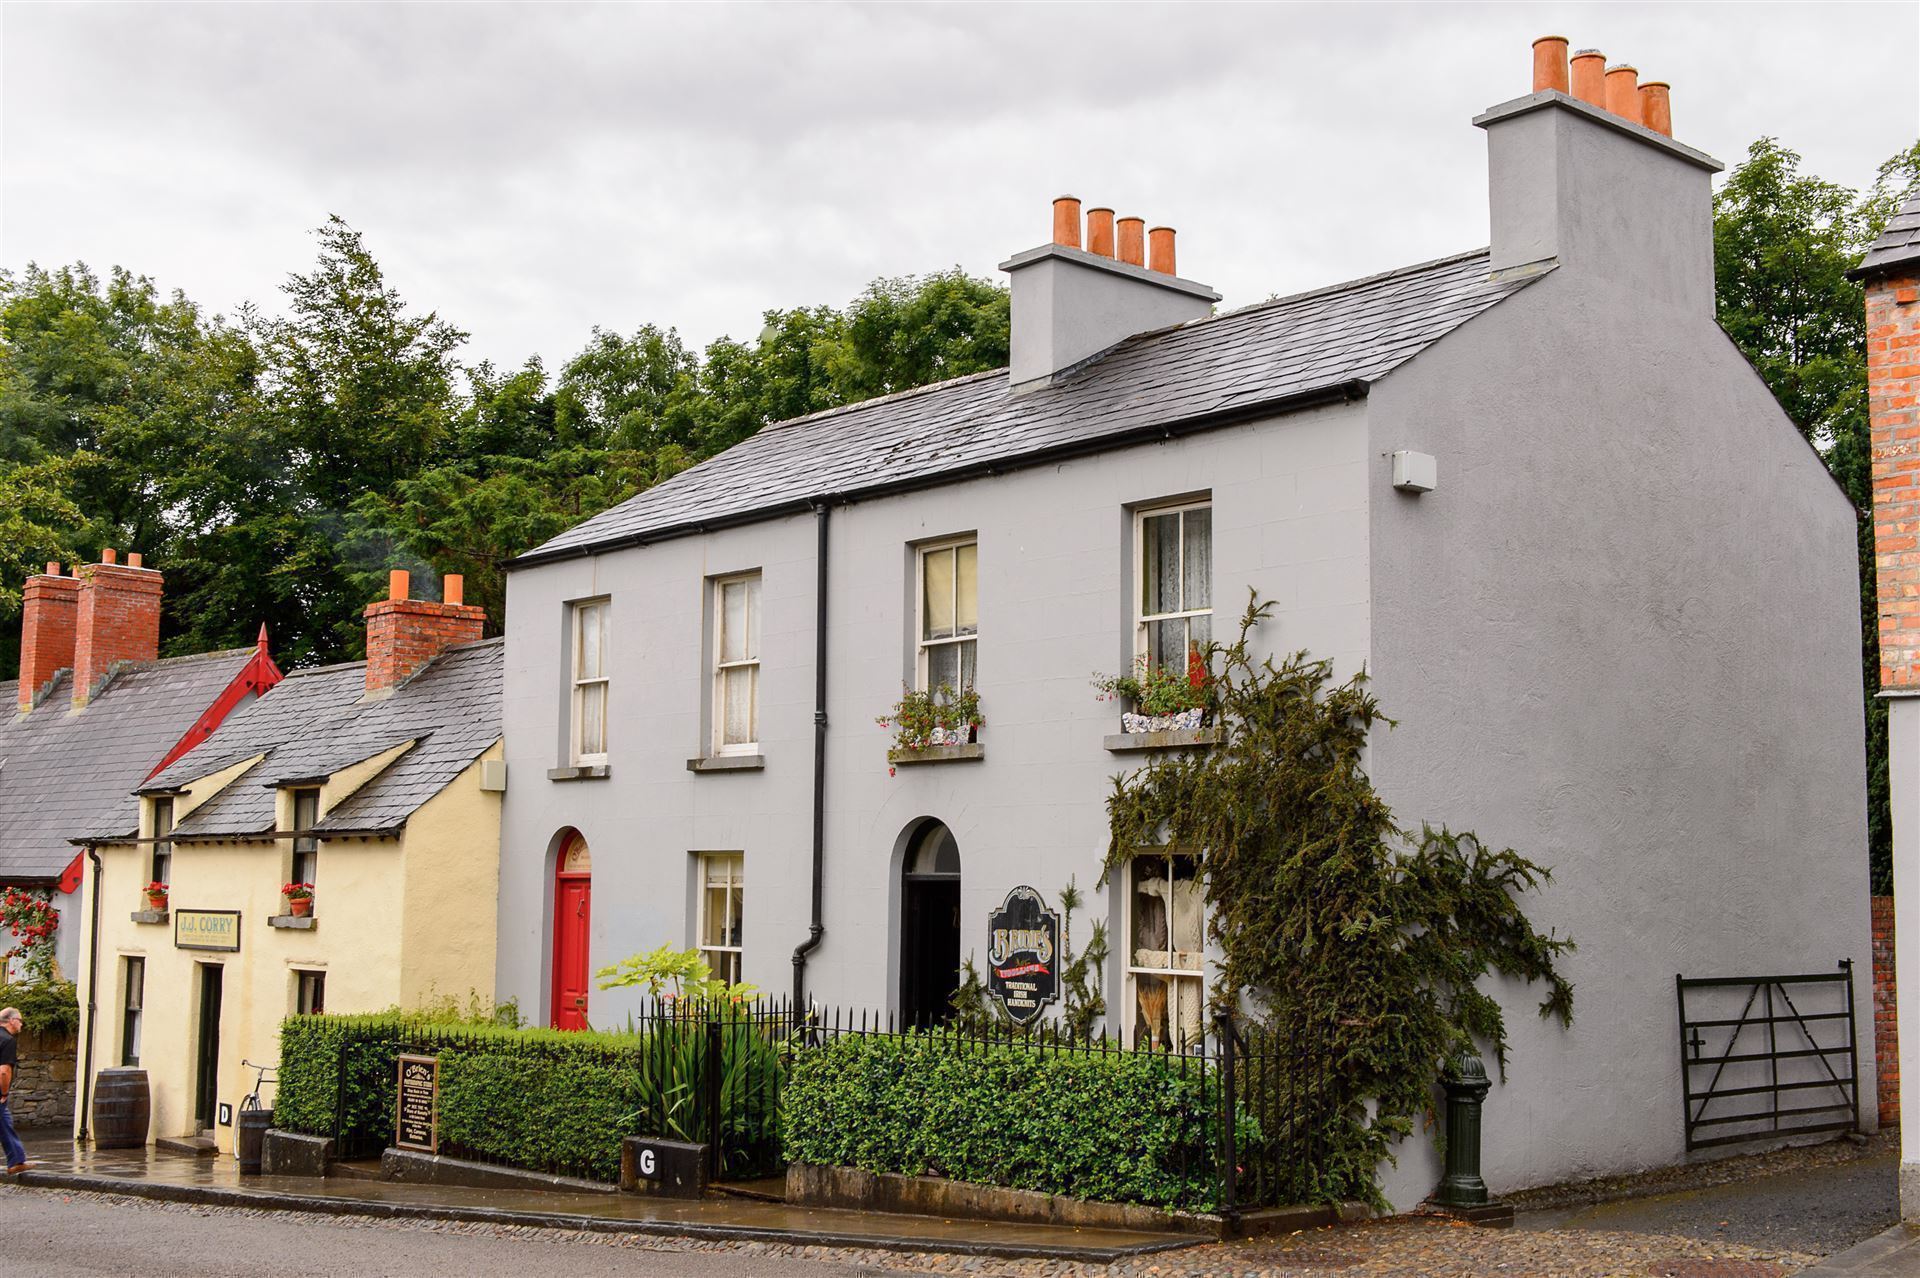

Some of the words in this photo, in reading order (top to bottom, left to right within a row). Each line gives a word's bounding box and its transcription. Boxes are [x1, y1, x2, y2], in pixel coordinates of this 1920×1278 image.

[199, 916, 233, 933] CORRY
[990, 924, 1053, 966] BRIDIE'S
[1005, 981, 1037, 991] TRADITIONAL
[1013, 990, 1028, 999] IRISH
[1007, 998, 1036, 1008] HANDKNITS
[221, 1105, 229, 1123] D
[640, 1149, 655, 1175] G
